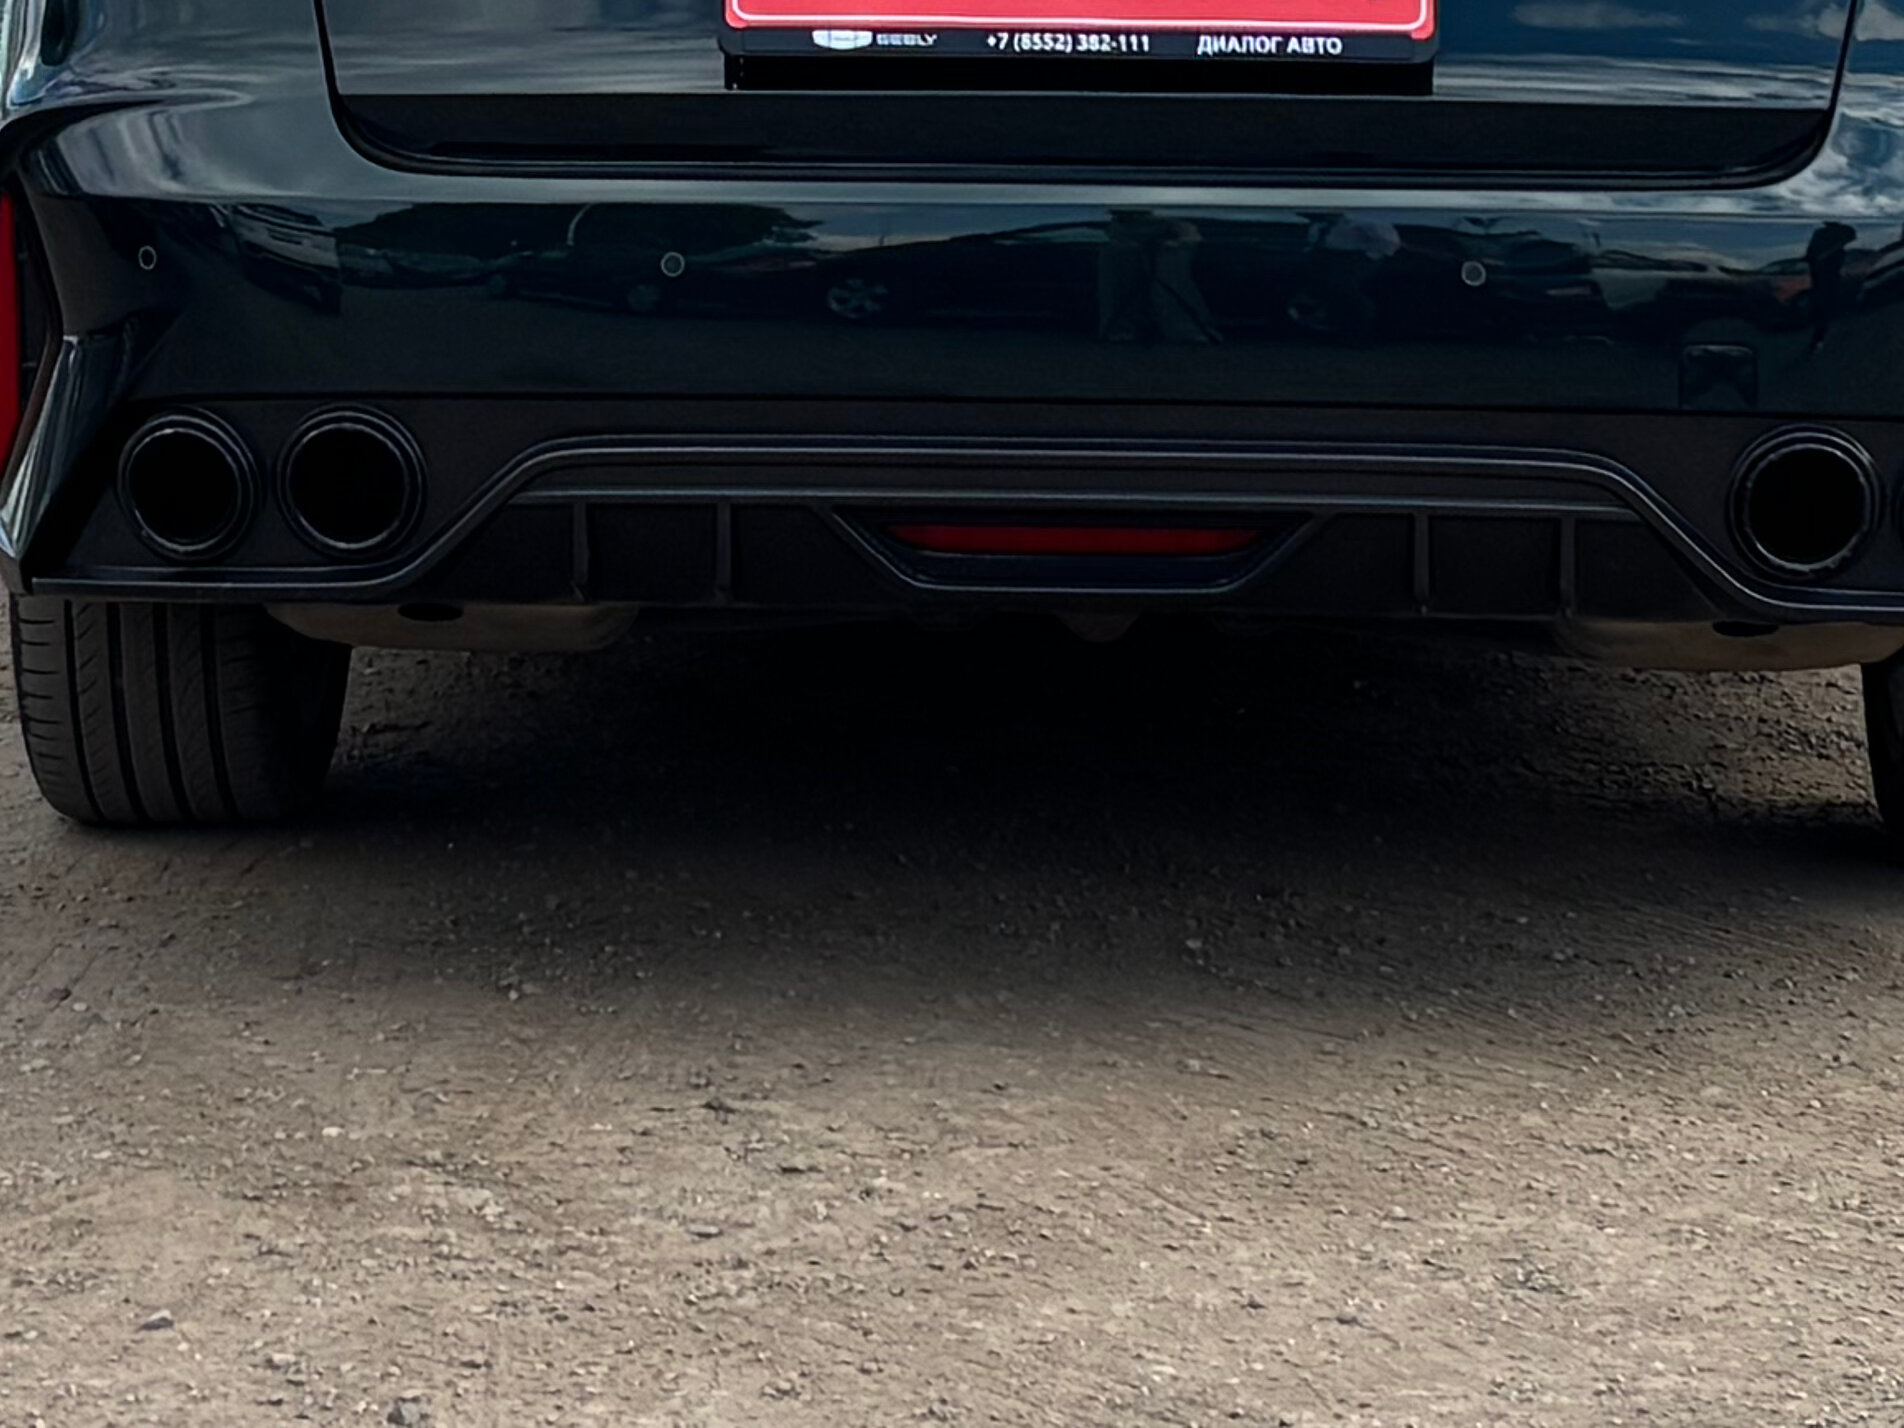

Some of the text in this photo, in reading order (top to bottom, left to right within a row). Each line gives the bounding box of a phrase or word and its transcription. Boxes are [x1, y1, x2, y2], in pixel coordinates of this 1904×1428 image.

[987, 32, 1008, 51] +7
[1197, 34, 1343, 56] ДИАЛОГ АВТО
